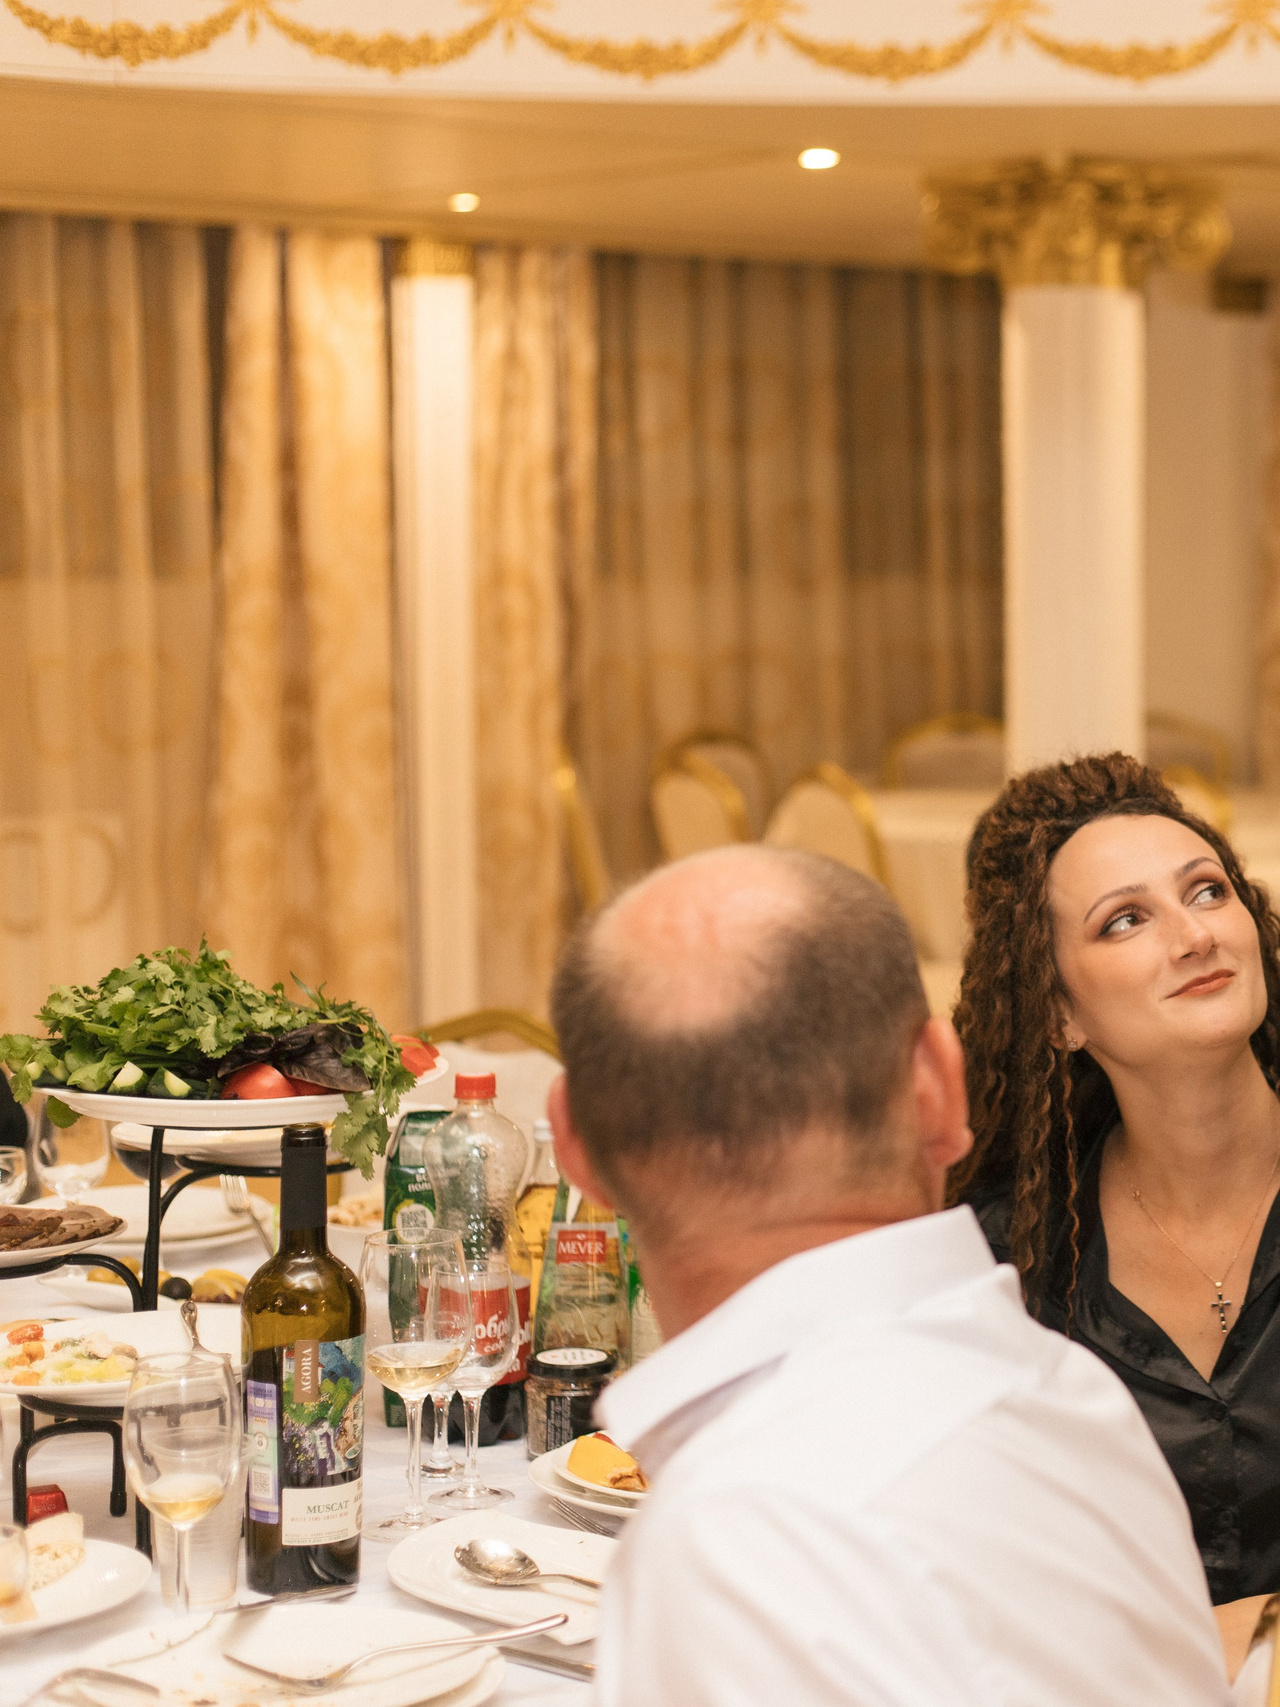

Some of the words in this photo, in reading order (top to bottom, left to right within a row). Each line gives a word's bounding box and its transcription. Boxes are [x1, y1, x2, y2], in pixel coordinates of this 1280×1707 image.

[558, 1241, 604, 1255] MEVER
[301, 1347, 312, 1393] AGORA
[306, 1499, 350, 1515] MUSCAT
